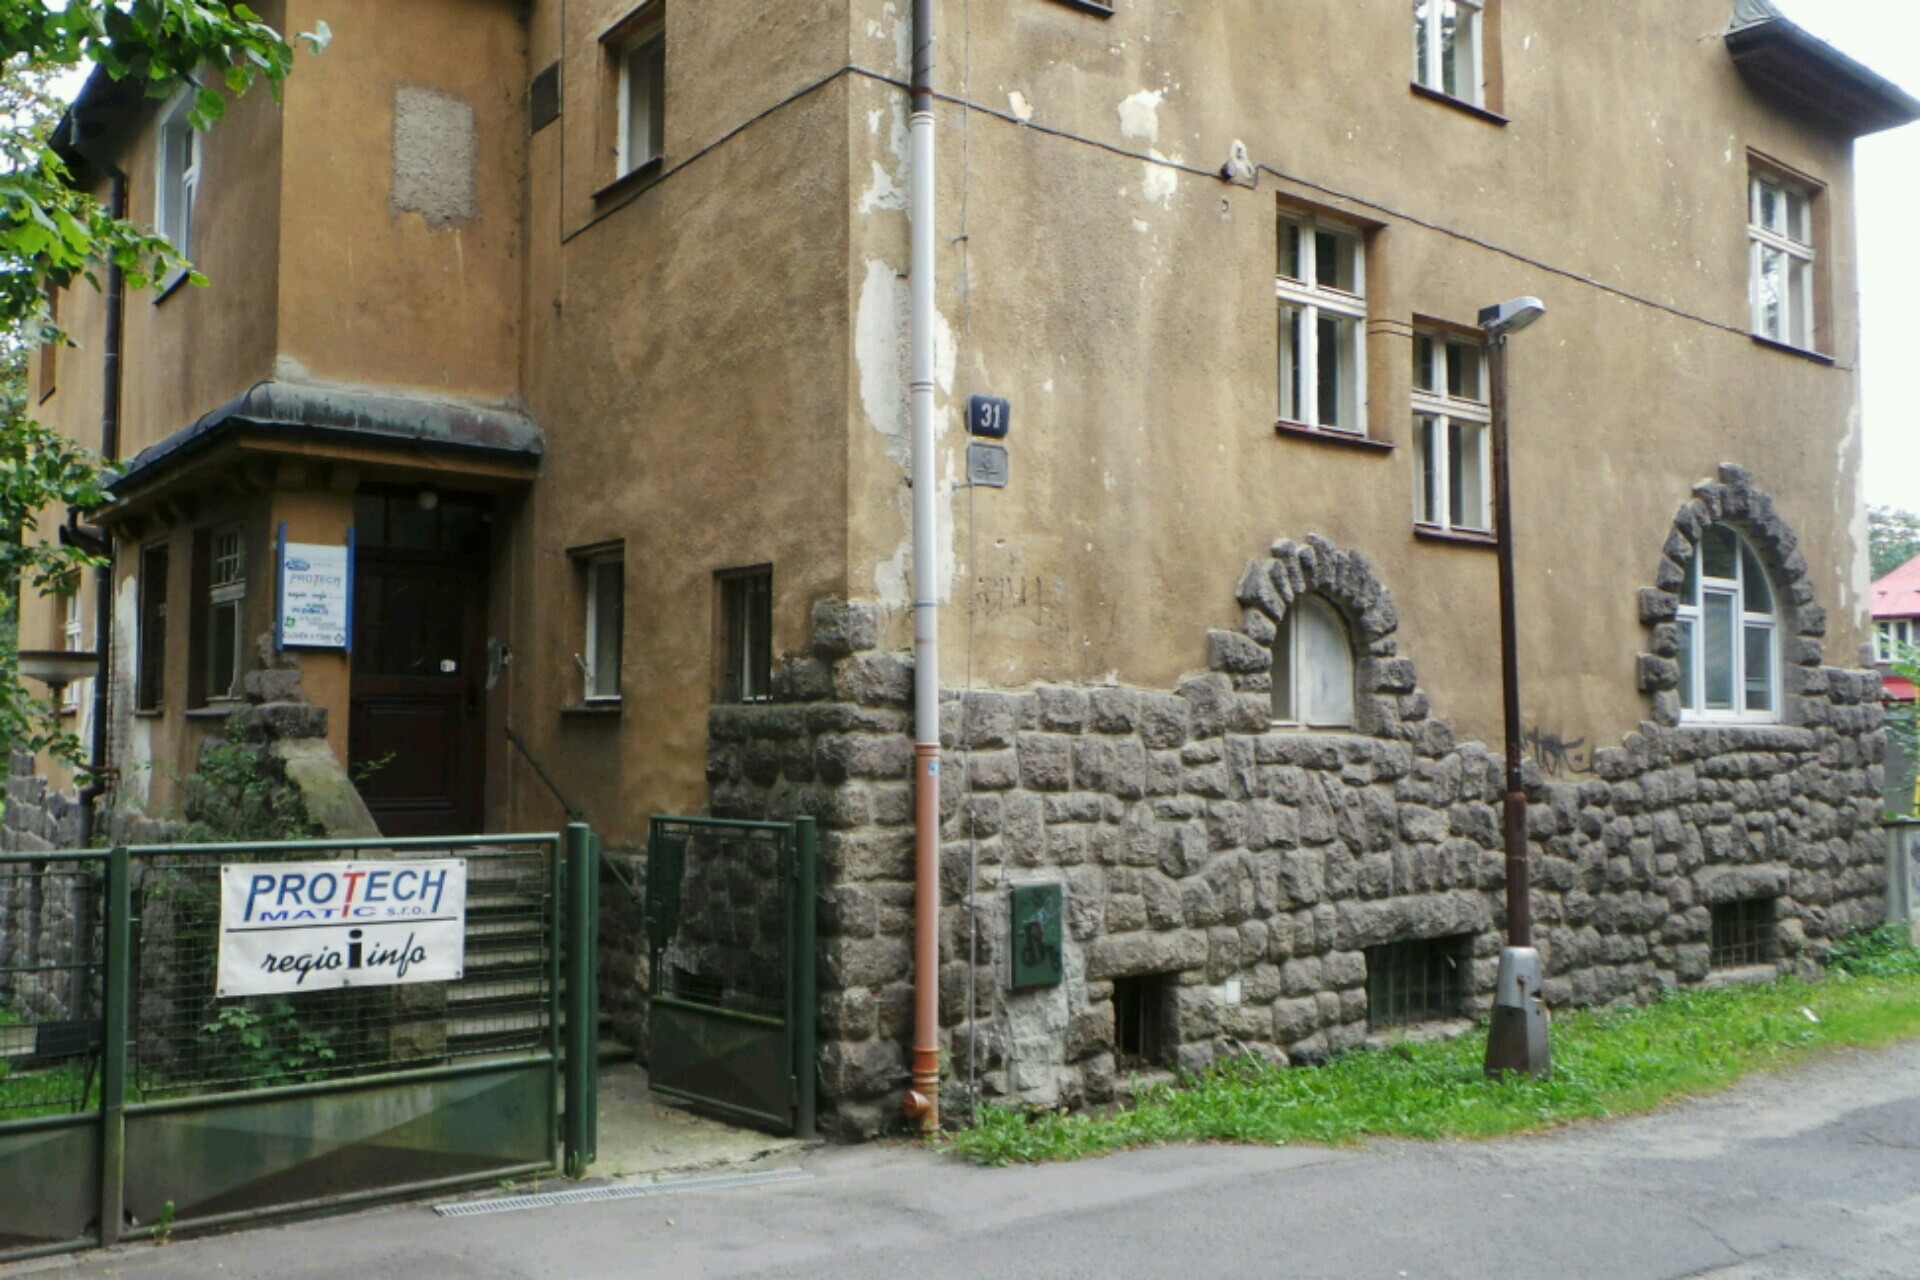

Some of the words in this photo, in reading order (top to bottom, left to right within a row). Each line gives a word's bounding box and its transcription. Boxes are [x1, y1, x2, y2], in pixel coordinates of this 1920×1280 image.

[981, 403, 1001, 429] 31
[243, 869, 447, 922] PROTECH
[259, 904, 377, 921] MATIC
[387, 904, 425, 917] s.r.o.
[261, 946, 343, 985] regio
[346, 928, 363, 969] i
[366, 932, 427, 978] info
